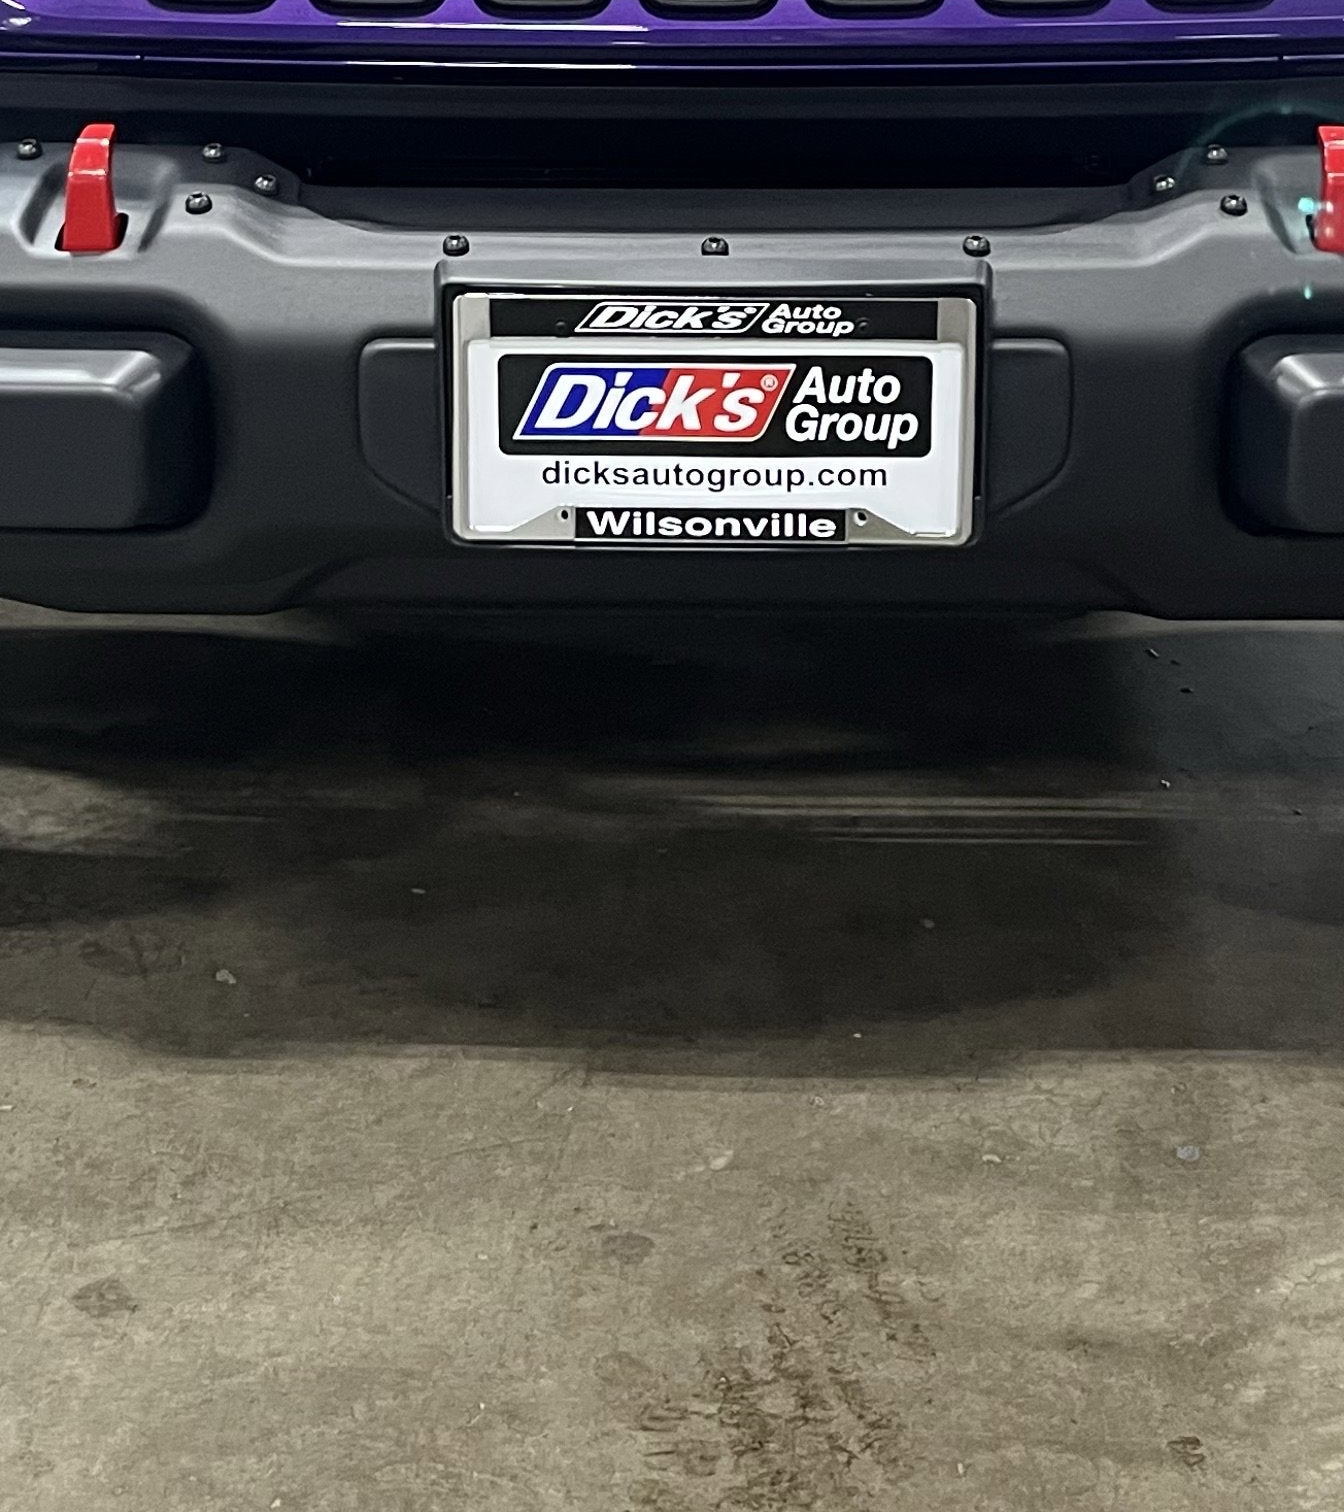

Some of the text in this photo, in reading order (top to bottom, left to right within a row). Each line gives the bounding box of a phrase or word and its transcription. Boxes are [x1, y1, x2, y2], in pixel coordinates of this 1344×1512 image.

[588, 303, 842, 330] Dick's Auto
[761, 319, 855, 337] Group
[534, 366, 901, 431] Dick's Auto
[785, 404, 919, 450] Group
[541, 460, 888, 492] dicksautogroup.com
[586, 510, 837, 538] Wilsonville
